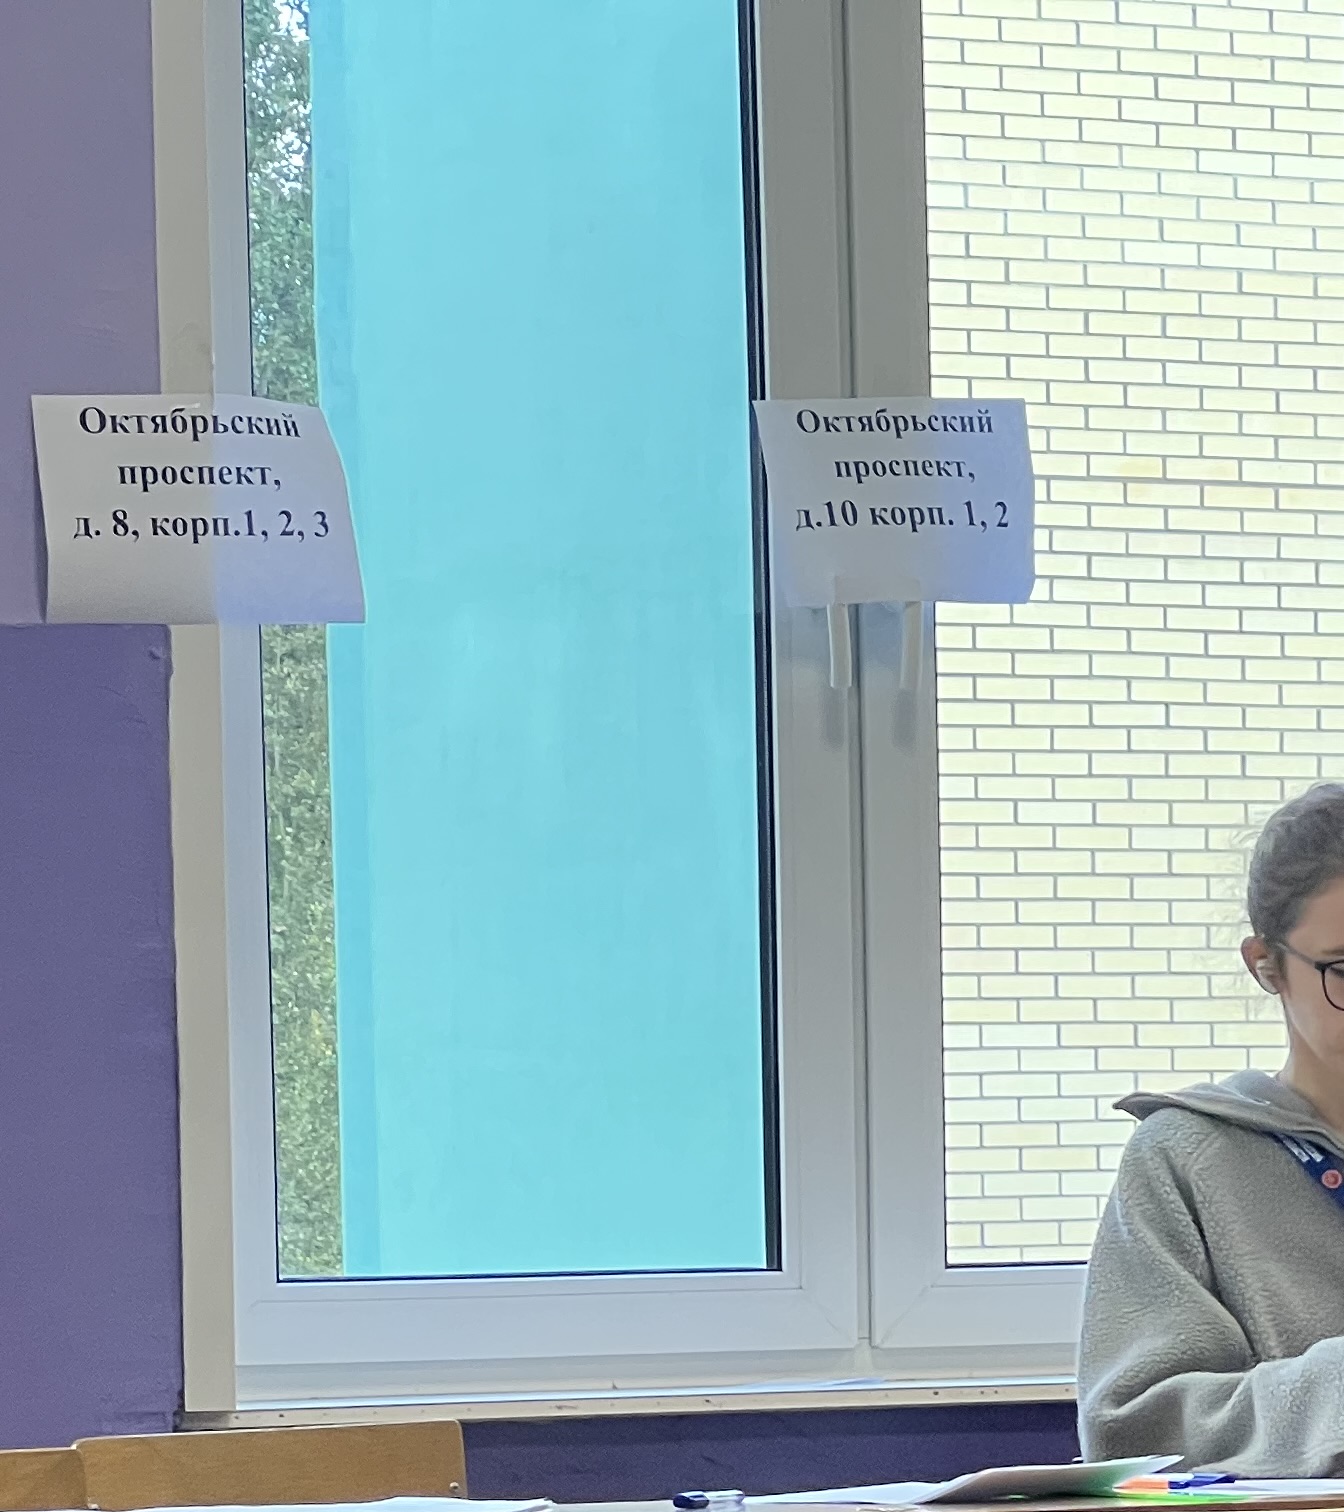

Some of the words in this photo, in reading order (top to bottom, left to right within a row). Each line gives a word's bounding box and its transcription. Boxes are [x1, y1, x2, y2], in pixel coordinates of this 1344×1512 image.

[78, 406, 301, 443] Октябрьский
[796, 407, 994, 440] Октябрьский
[116, 465, 281, 494] проспект,
[834, 459, 976, 485] проспект,
[73, 517, 104, 540] д.
[109, 508, 140, 543] 8,
[277, 509, 305, 543] 2,
[312, 510, 329, 538] 3
[795, 499, 858, 532] д.10
[868, 506, 955, 534] корп.
[963, 499, 988, 533] 1,
[994, 501, 1009, 528] 2
